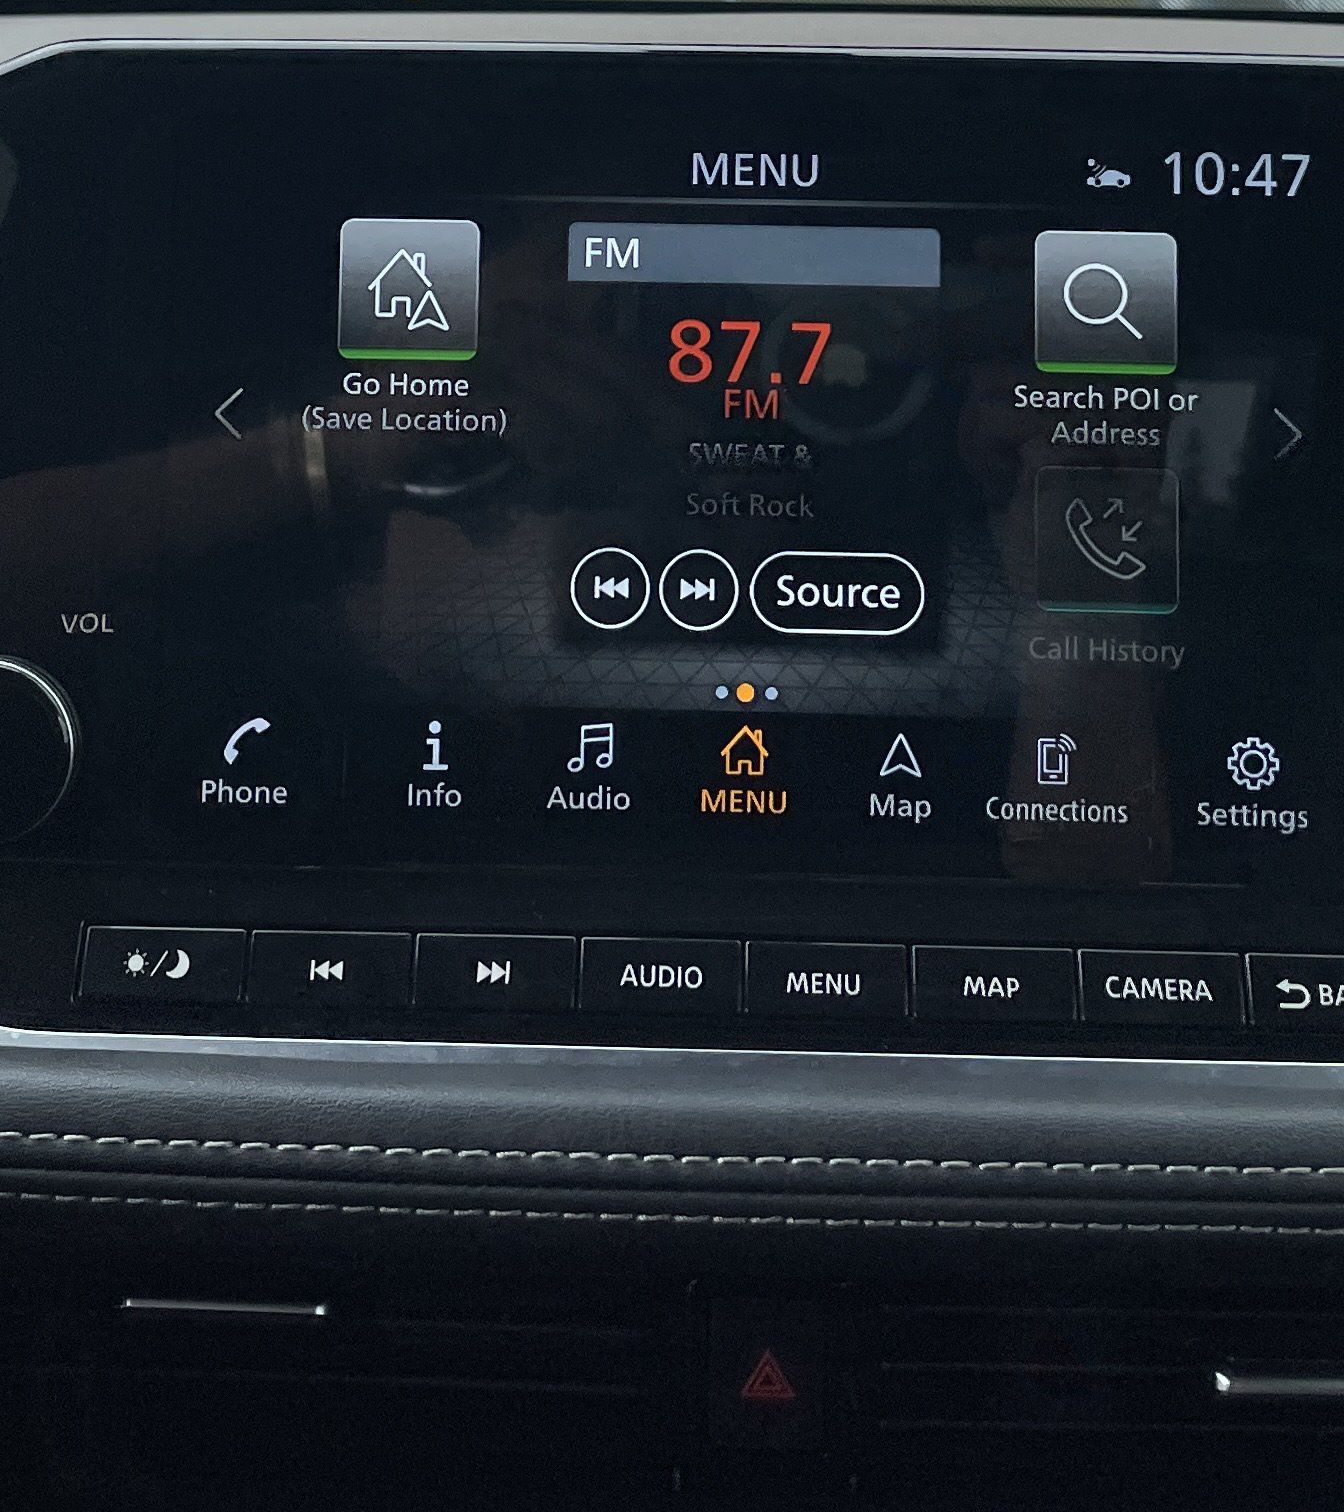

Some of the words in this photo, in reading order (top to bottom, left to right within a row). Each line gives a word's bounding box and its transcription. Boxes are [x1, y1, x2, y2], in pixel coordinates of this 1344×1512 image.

[692, 152, 819, 188] MENU
[1164, 151, 1310, 197] 10:47
[585, 237, 639, 268] FM
[669, 319, 831, 384] 87.7
[343, 372, 381, 395] Go
[390, 372, 469, 397] Home
[1014, 384, 1104, 409] Search
[1114, 387, 1159, 411] POI
[1168, 394, 1199, 411] or
[724, 388, 778, 419] FM
[302, 404, 373, 433] (Save
[381, 407, 507, 436] Location)
[1051, 419, 1160, 446] Address
[689, 442, 786, 467] SWEAT
[793, 444, 813, 467] &
[687, 491, 740, 516] Soft
[749, 493, 814, 518] Rock
[776, 574, 901, 609] Source
[61, 612, 114, 634] VOL
[1028, 635, 1078, 660] Call
[1088, 637, 1185, 669] History
[201, 778, 288, 804] Phone
[407, 781, 462, 807] Info
[546, 784, 631, 811] Audio
[700, 788, 787, 814] MENU
[869, 793, 932, 824] Map
[985, 796, 1128, 824] Connections
[1197, 801, 1308, 835] Settings
[619, 963, 703, 989] AUDIO
[786, 972, 861, 996] MENU
[963, 975, 1020, 998] MAP
[1105, 975, 1213, 1001] CAMERA
